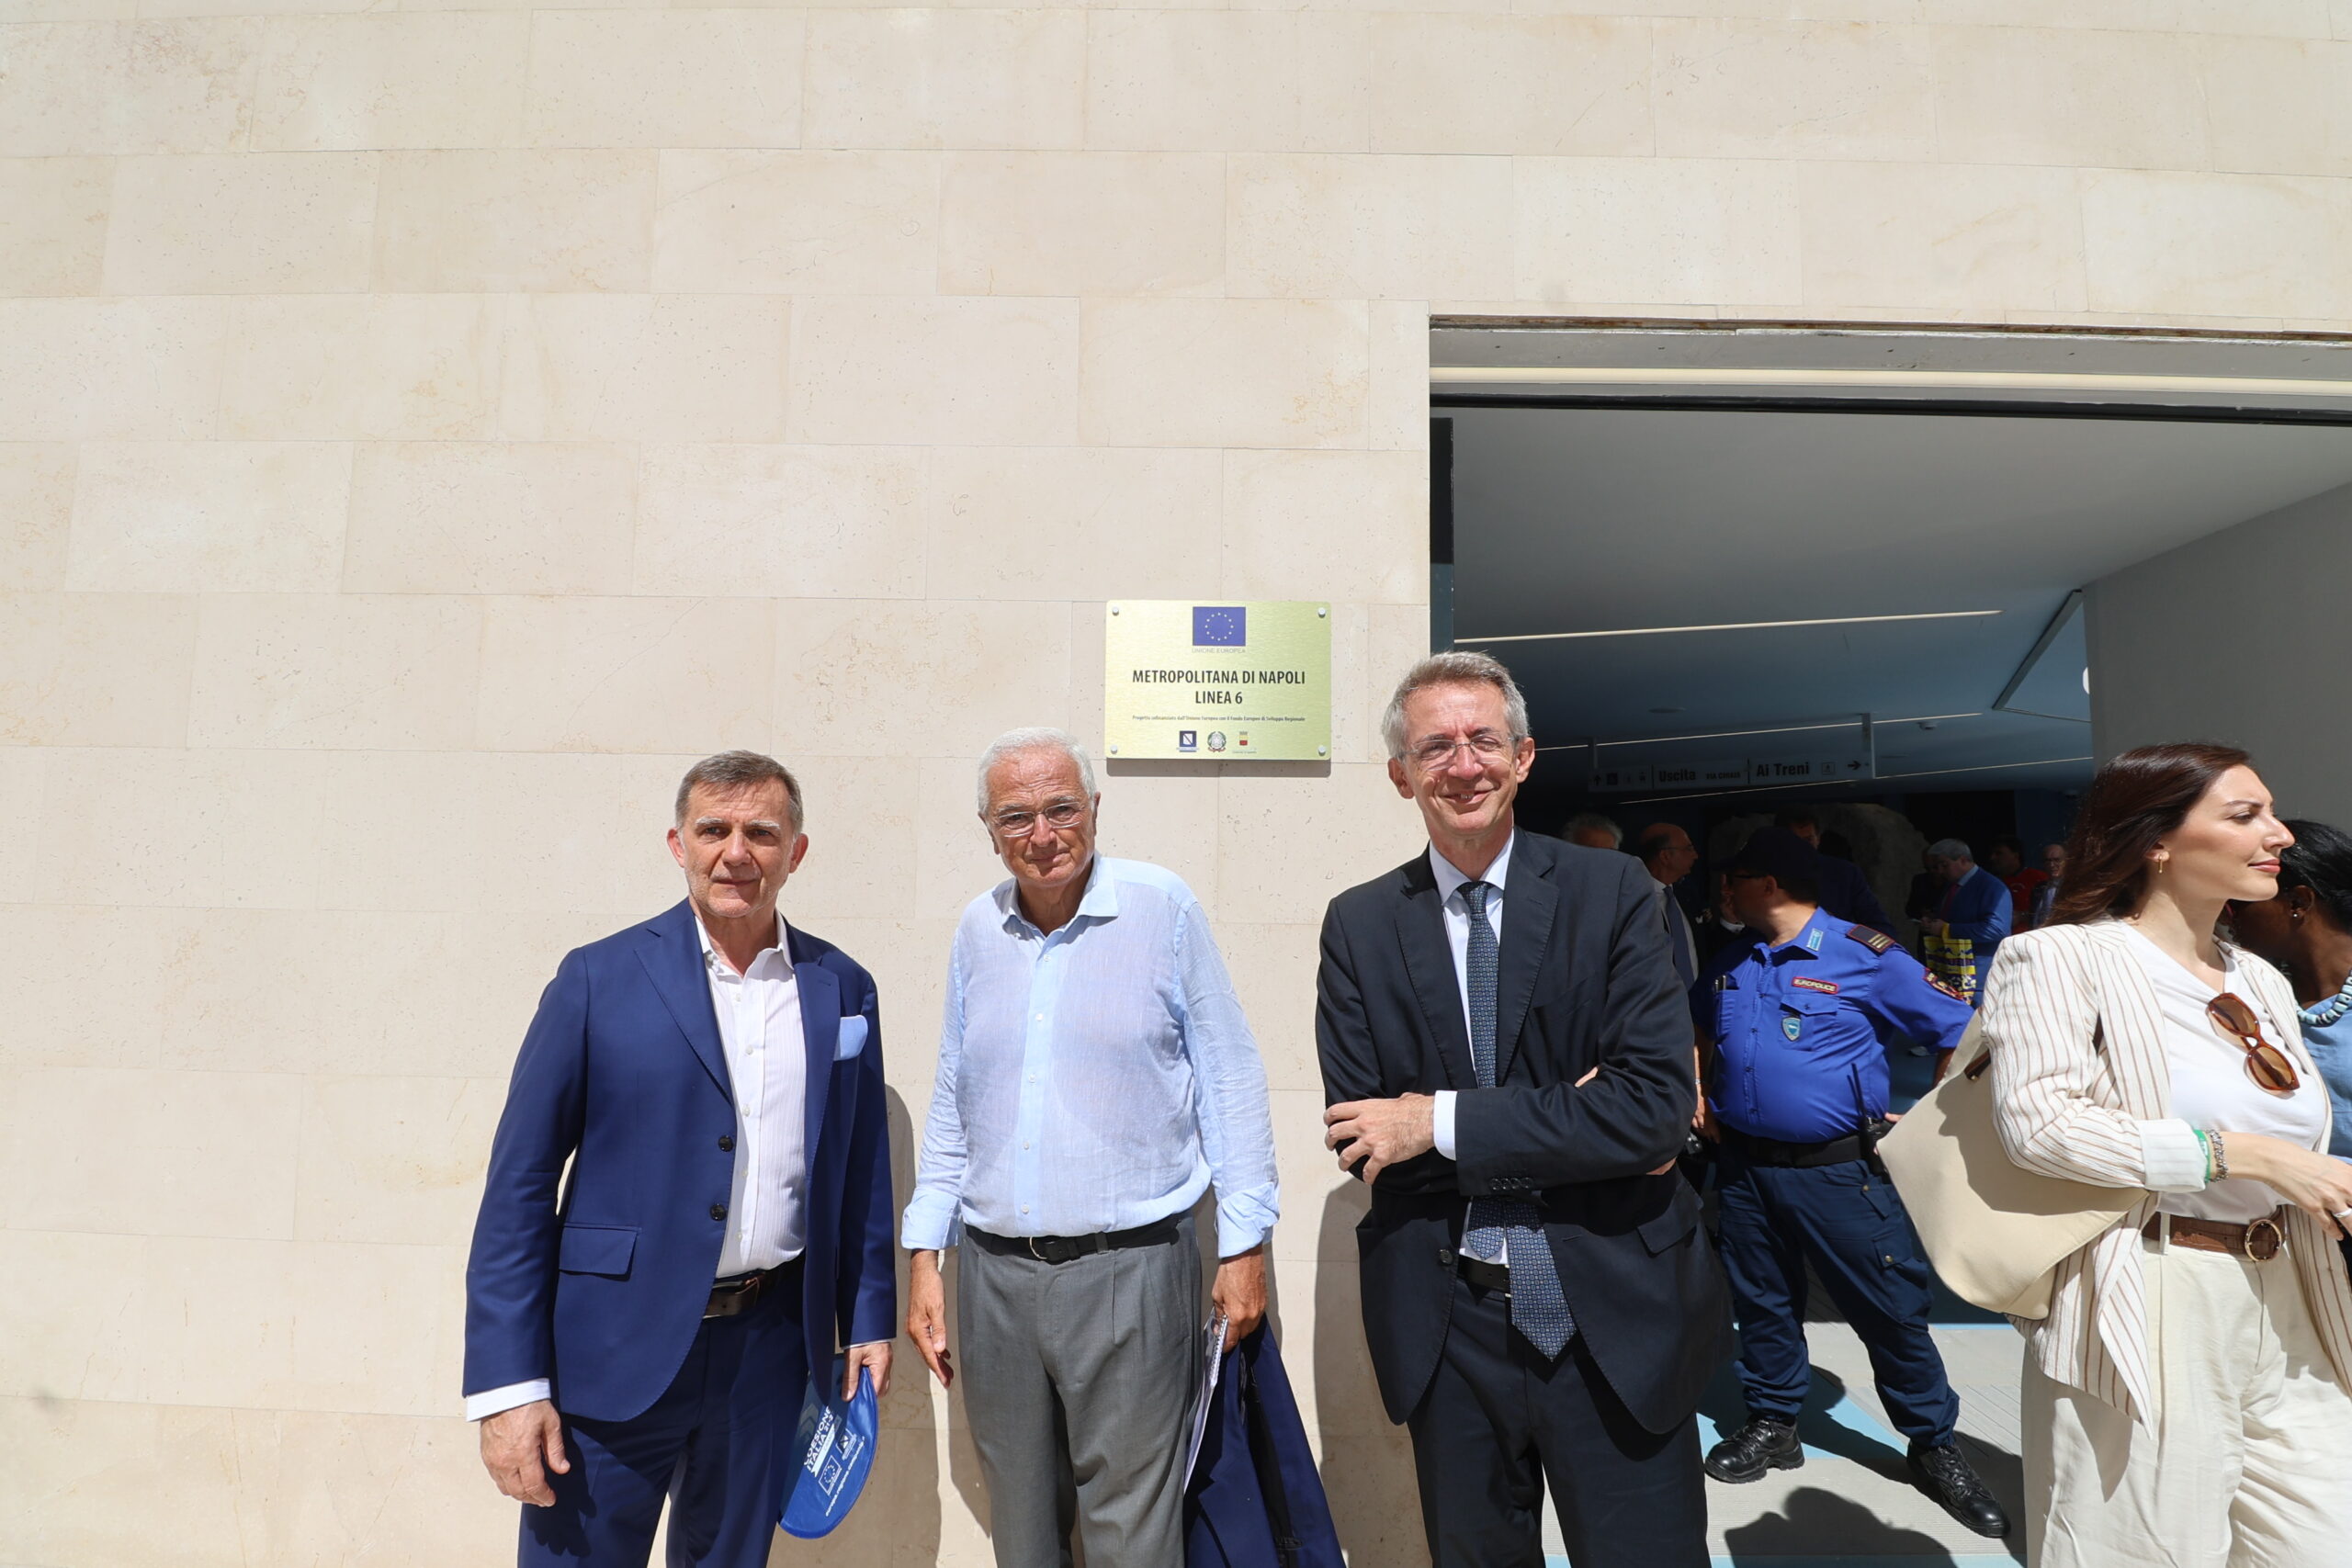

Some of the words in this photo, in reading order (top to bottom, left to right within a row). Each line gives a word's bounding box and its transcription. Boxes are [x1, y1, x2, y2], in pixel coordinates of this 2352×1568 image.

[1132, 670, 1238, 684] METROPOLITANA
[1242, 670, 1255, 684] DI
[1259, 671, 1306, 684] NAPOLI
[1195, 691, 1232, 705] LINEA
[1235, 691, 1243, 705] 6
[1658, 768, 1696, 783] Uscita
[1756, 763, 1769, 777] Ai
[1773, 761, 1809, 776] Treni
[806, 1434, 828, 1472] ITALIA
